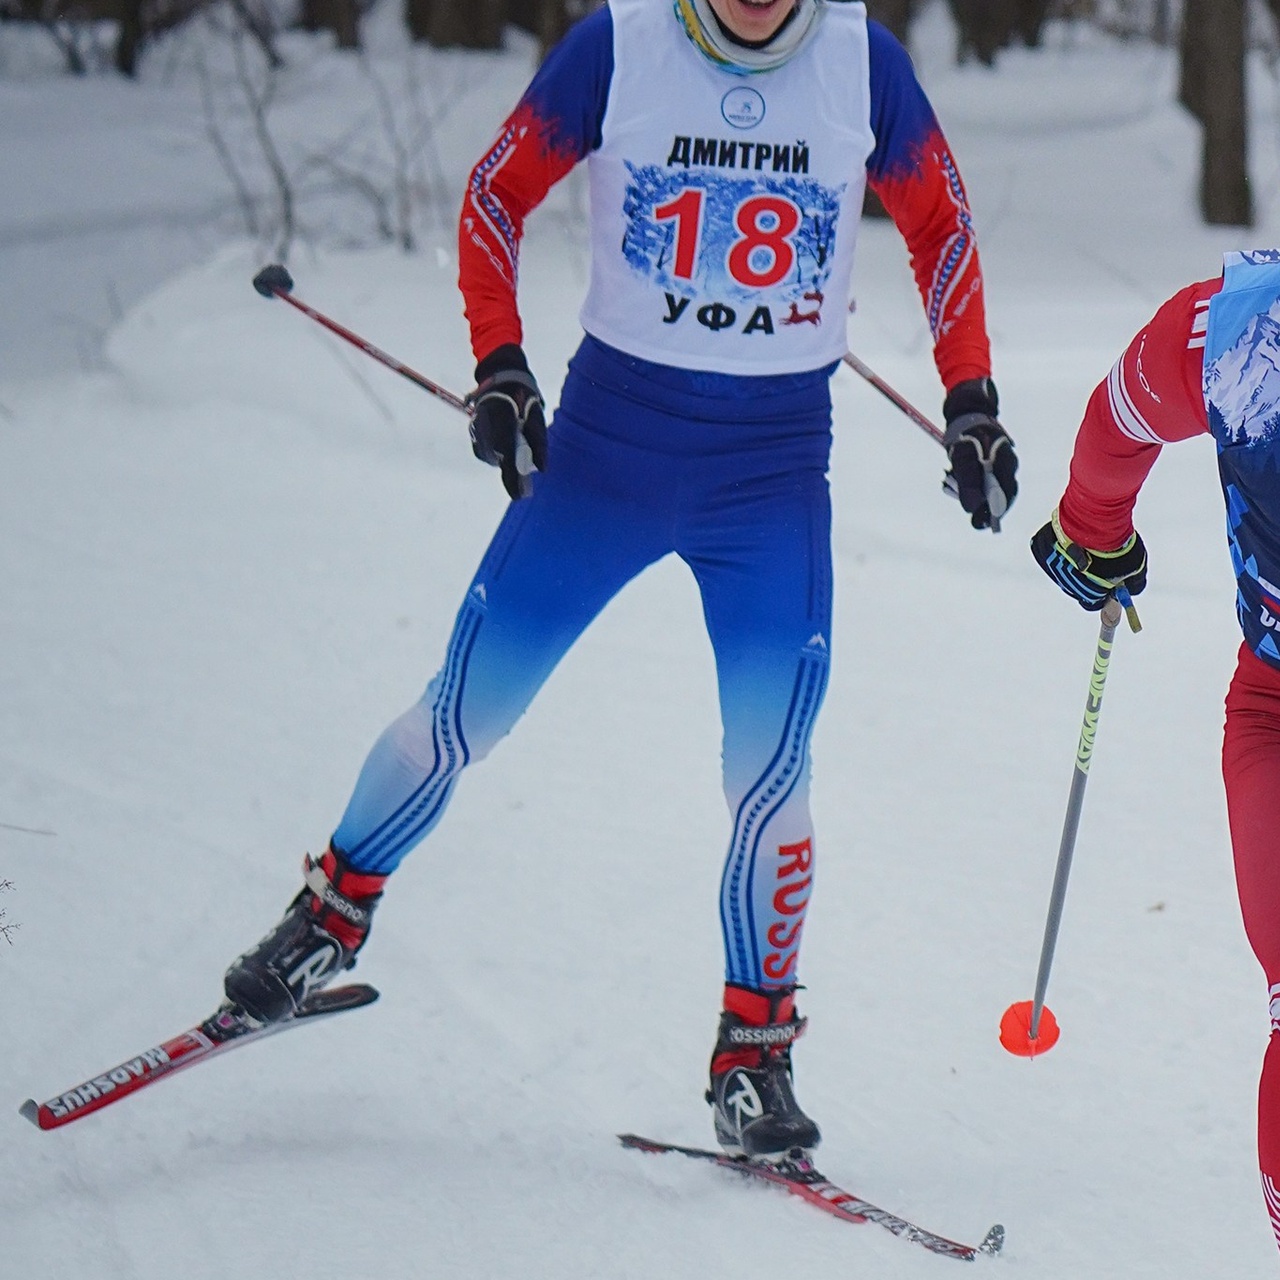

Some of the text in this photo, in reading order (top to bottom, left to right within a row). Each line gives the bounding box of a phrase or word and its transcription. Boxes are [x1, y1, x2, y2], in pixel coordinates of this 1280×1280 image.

[667, 135, 810, 174] ДМИТРИЙ
[653, 187, 801, 289] 18
[663, 292, 775, 335] УФА
[44, 1046, 171, 1118] MADSHUS
